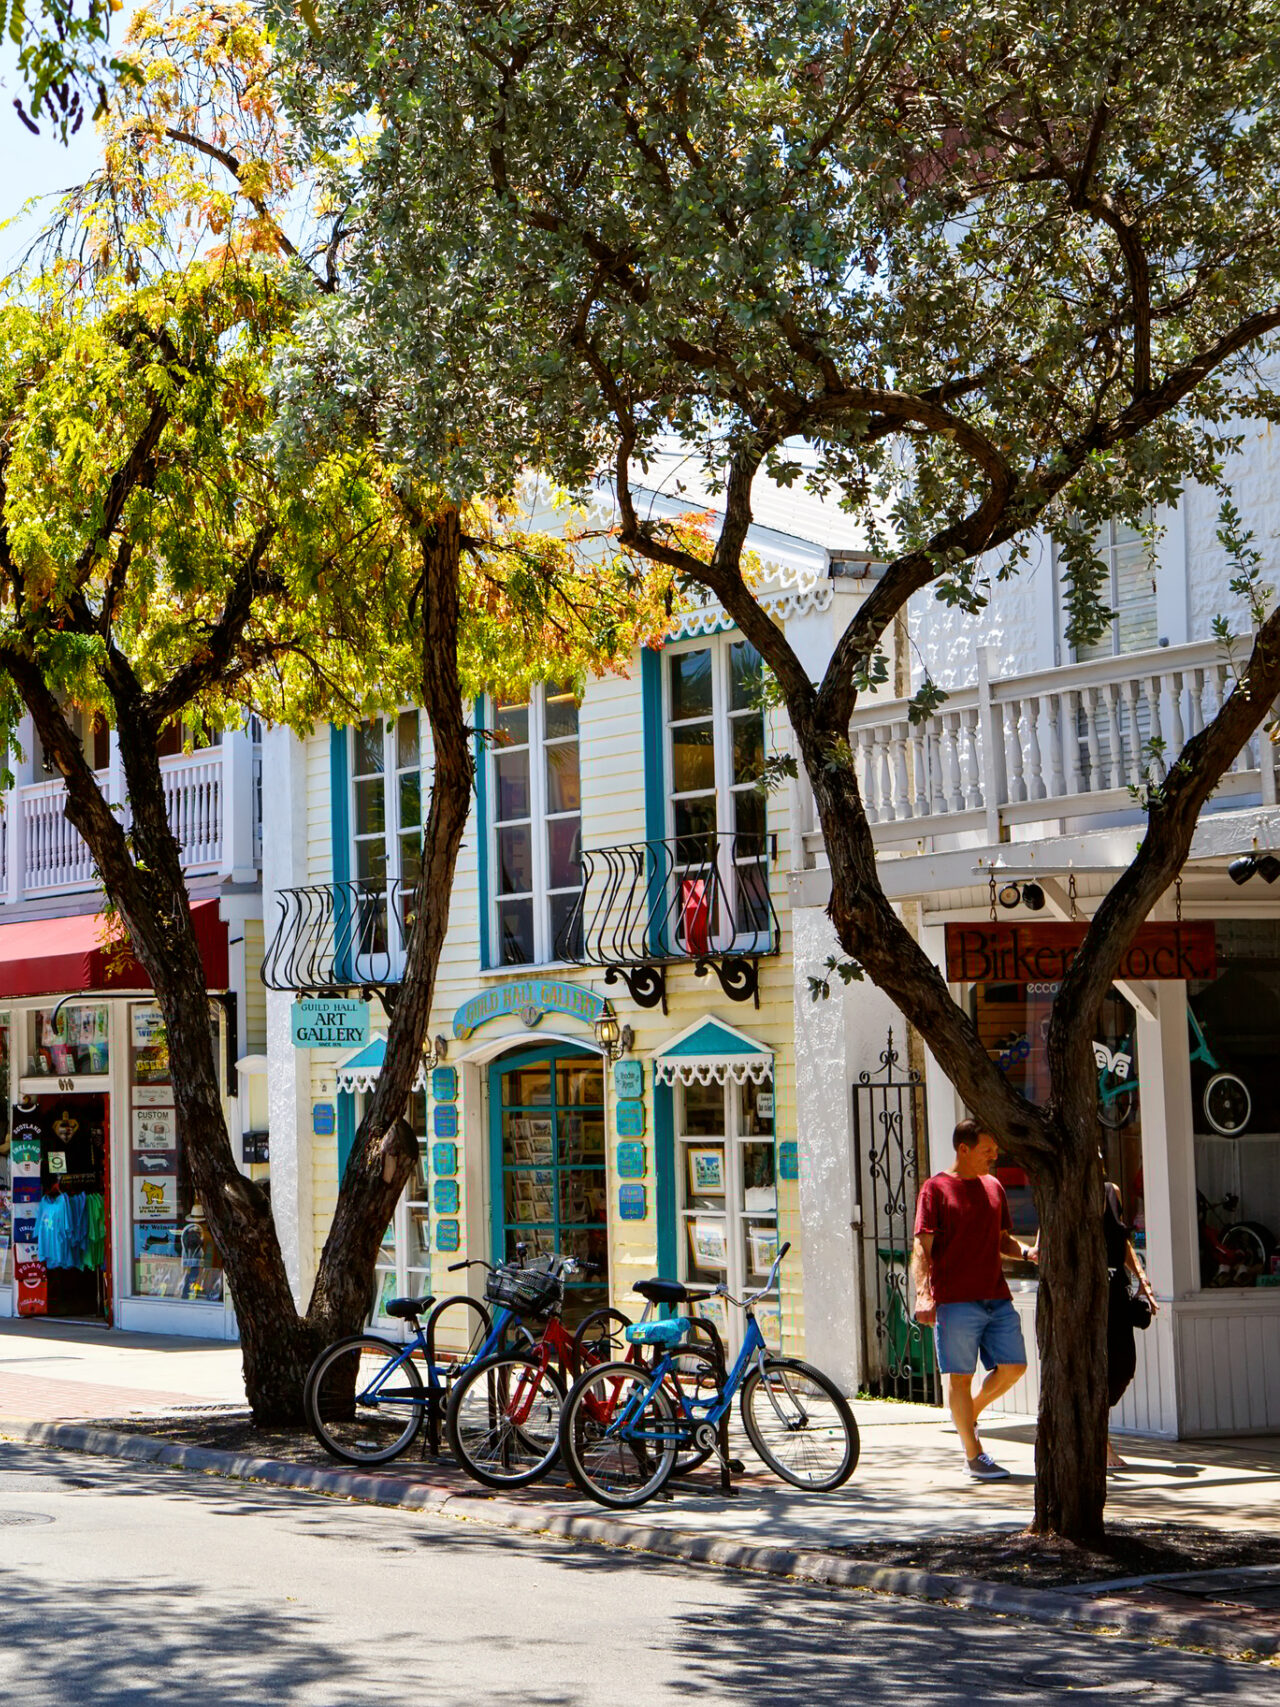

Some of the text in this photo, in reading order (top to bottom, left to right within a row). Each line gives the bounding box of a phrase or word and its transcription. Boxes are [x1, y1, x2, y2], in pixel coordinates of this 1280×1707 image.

[1026, 983, 1059, 994] ecco
[301, 1003, 358, 1012] GUILD HALL
[465, 984, 598, 1024] GUILD HALL GALLERY
[314, 1012, 347, 1026] ART
[296, 1027, 365, 1042] GALLERY
[137, 1111, 169, 1119] CUSTOM
[13, 1123, 42, 1135] SCOTLAND
[12, 1143, 41, 1155] IRELAND
[18, 1262, 46, 1274] POLAND
